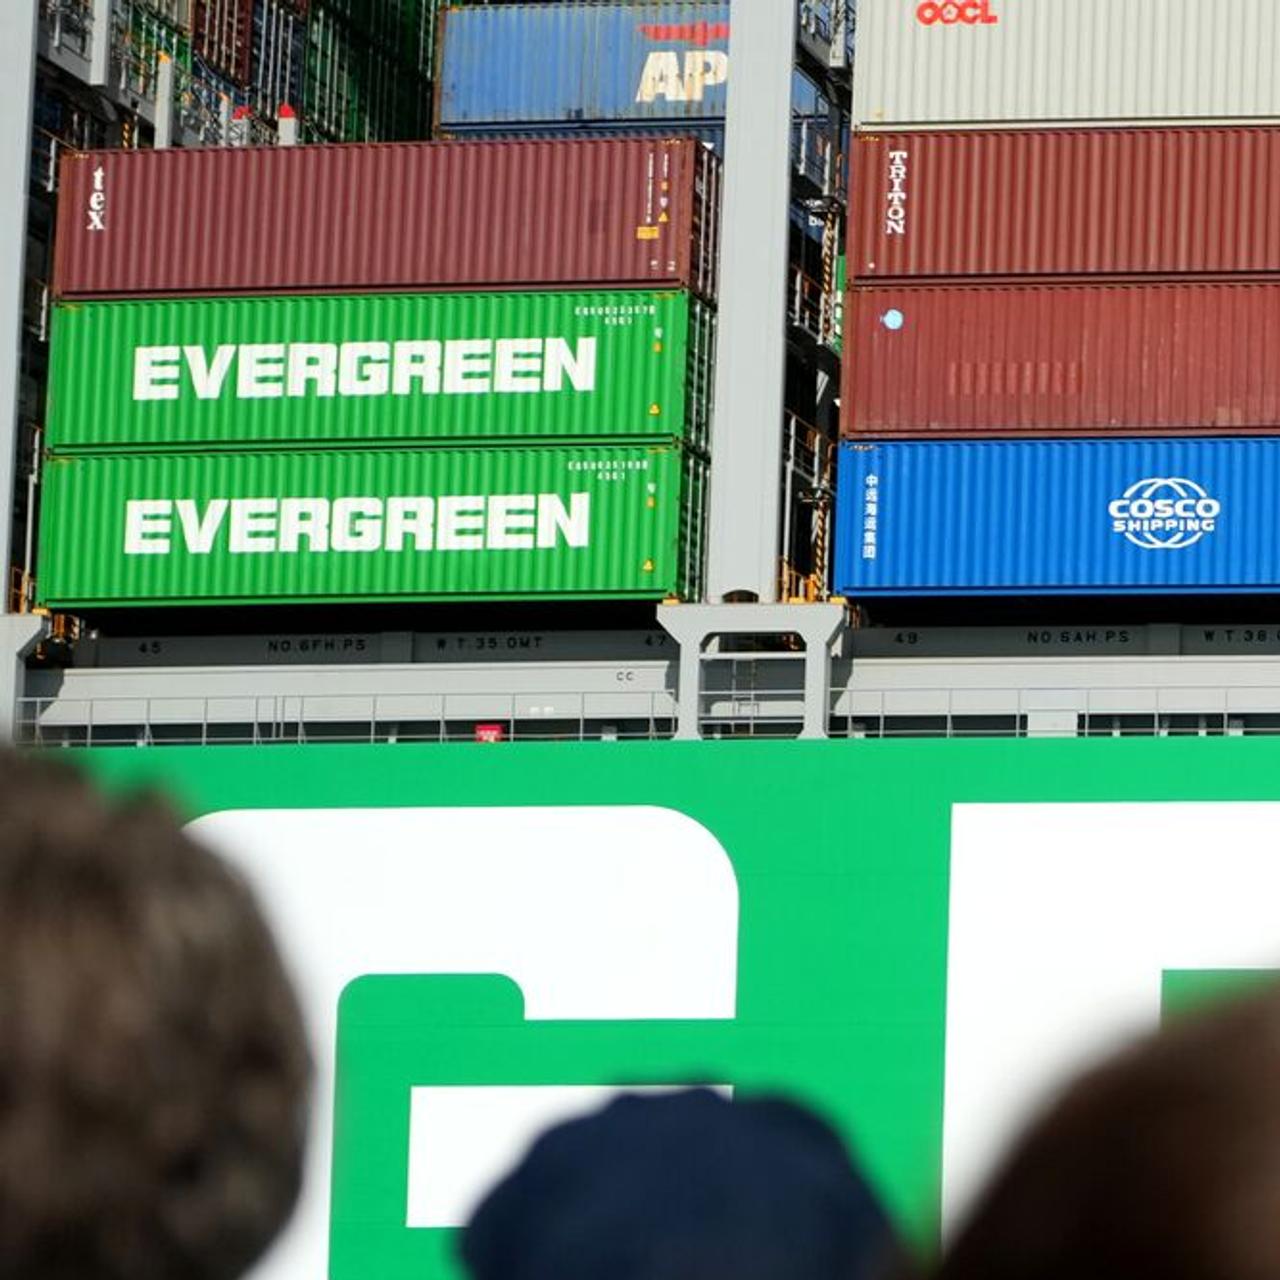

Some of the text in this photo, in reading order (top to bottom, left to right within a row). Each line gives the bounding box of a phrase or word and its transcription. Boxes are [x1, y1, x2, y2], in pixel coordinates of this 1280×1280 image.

[917, 0, 998, 25] OOCL
[86, 166, 105, 231] tex
[886, 151, 908, 234] TRITON
[132, 336, 597, 401] EVERGREEN
[1108, 499, 1220, 518] COSCO
[123, 491, 591, 555] EVERGREEN
[1113, 519, 1215, 532] SHIPPING
[138, 641, 162, 654] 45
[616, 671, 634, 682] CC
